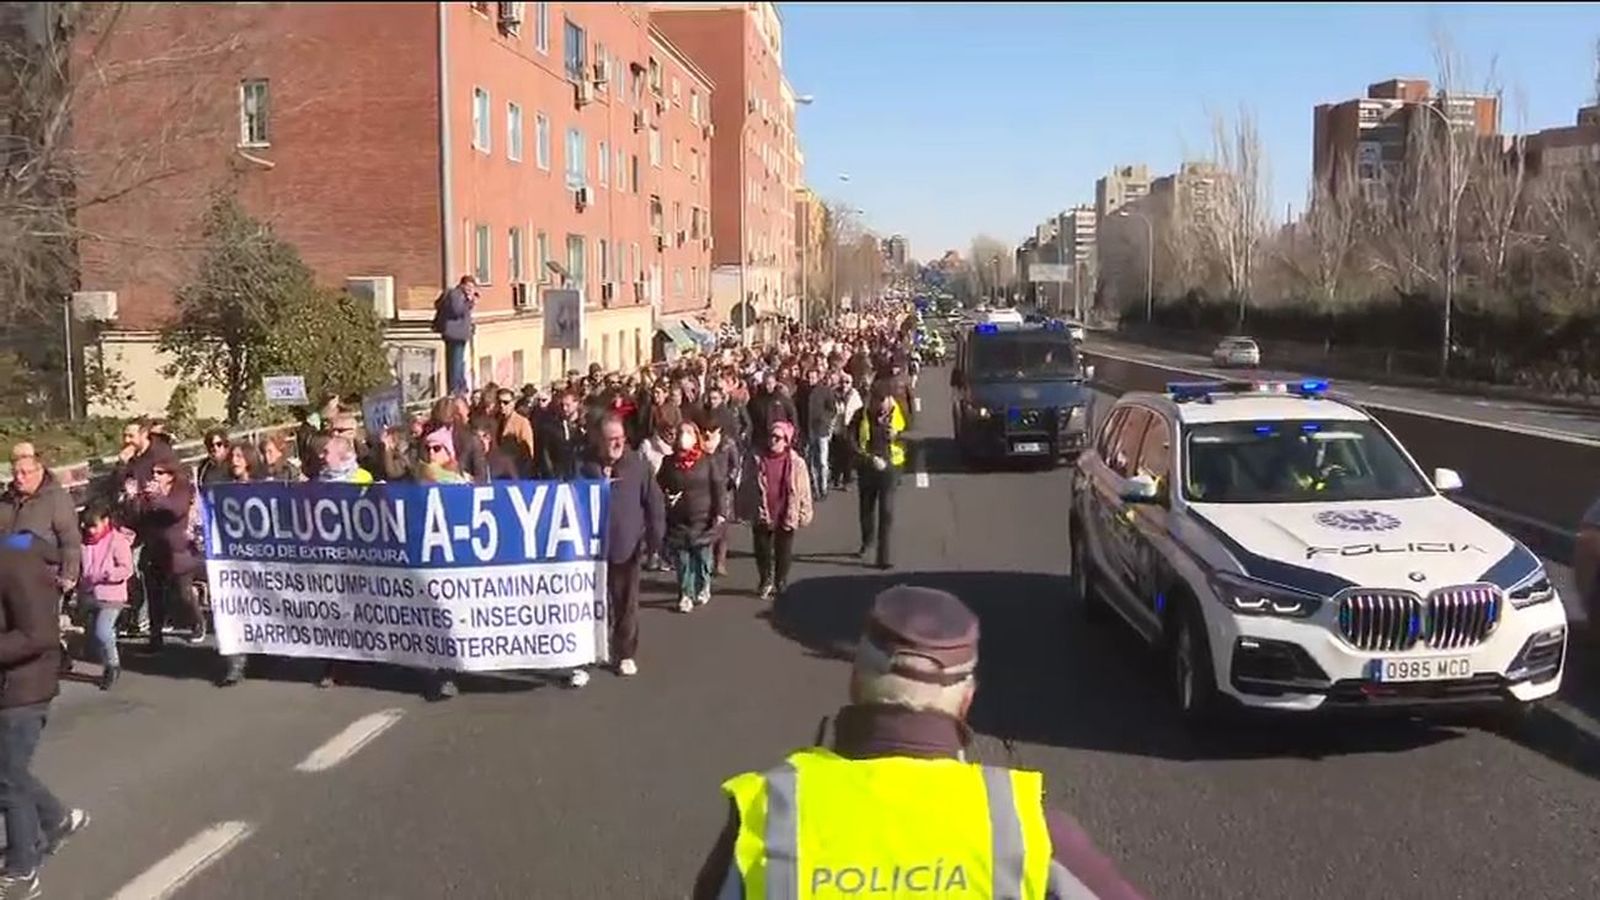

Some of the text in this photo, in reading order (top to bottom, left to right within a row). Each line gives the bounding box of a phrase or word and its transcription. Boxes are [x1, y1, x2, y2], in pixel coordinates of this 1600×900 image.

[421, 486, 498, 562] A-5
[507, 483, 601, 560] YA!
[228, 543, 409, 565] PASEO DE EXTREMADURA
[219, 569, 305, 592] PROMESAS
[306, 573, 415, 599] INCUMPLIDAS
[427, 568, 596, 600] CONTAMINACIÓN
[283, 599, 341, 620] RUIDOS
[353, 603, 453, 629] ACCIDENTES
[471, 601, 605, 628] INSEGURIDAD
[244, 624, 578, 658] BARRIOS DIVIDIDOS POR SUBTERRANEOS
[1386, 658, 1470, 679] 0985 MCD
[811, 858, 967, 895] POLICÍA
